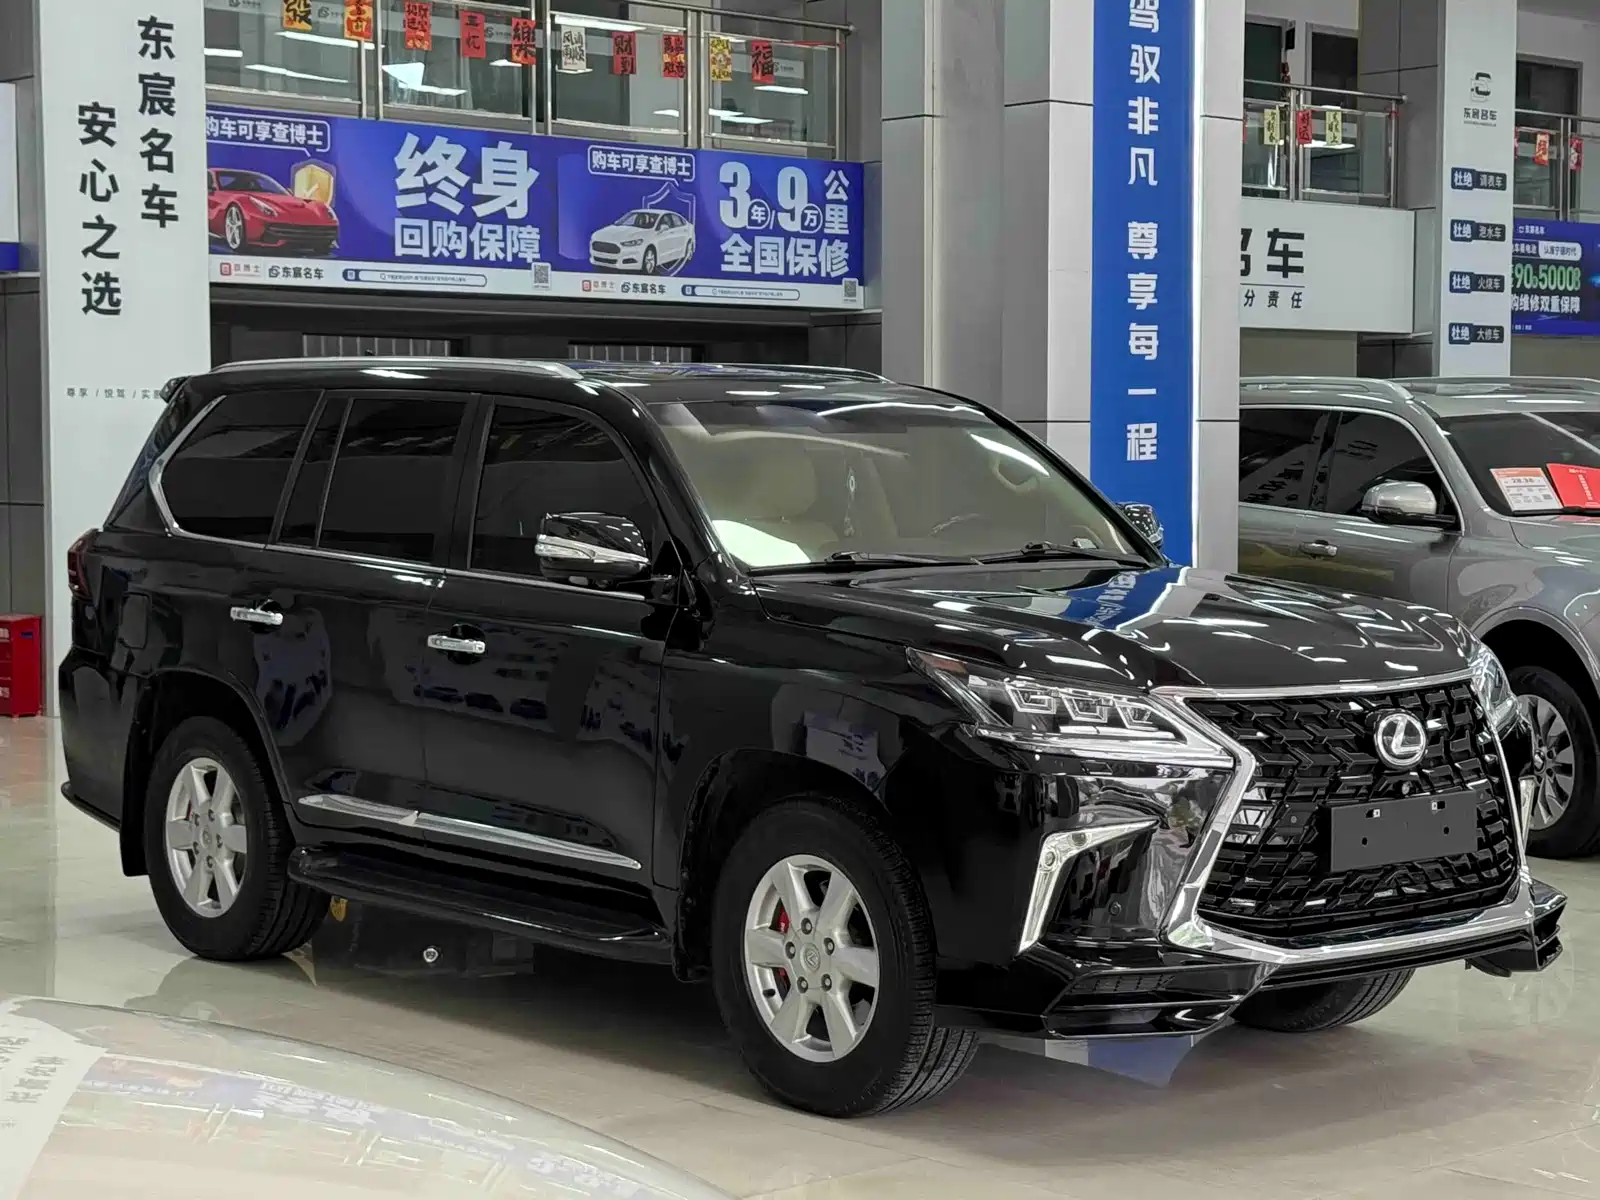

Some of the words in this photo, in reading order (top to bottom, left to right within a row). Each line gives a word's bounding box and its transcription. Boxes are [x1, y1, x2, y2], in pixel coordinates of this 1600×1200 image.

[751, 44, 773, 76] 福
[1128, 0, 1161, 186] 驾驭非凡
[137, 16, 179, 228] 东宸名车
[206, 116, 323, 145] 购车可享查博士
[394, 132, 540, 219] 终身
[592, 150, 691, 176] 购车可享查博士
[78, 101, 122, 316] 安心之选
[395, 218, 540, 263] 回购保障
[720, 233, 849, 277] 全国保修
[282, 266, 324, 279] 东宸名车
[1243, 289, 1303, 309] 分责任
[1126, 221, 1159, 462] 尊享每一程
